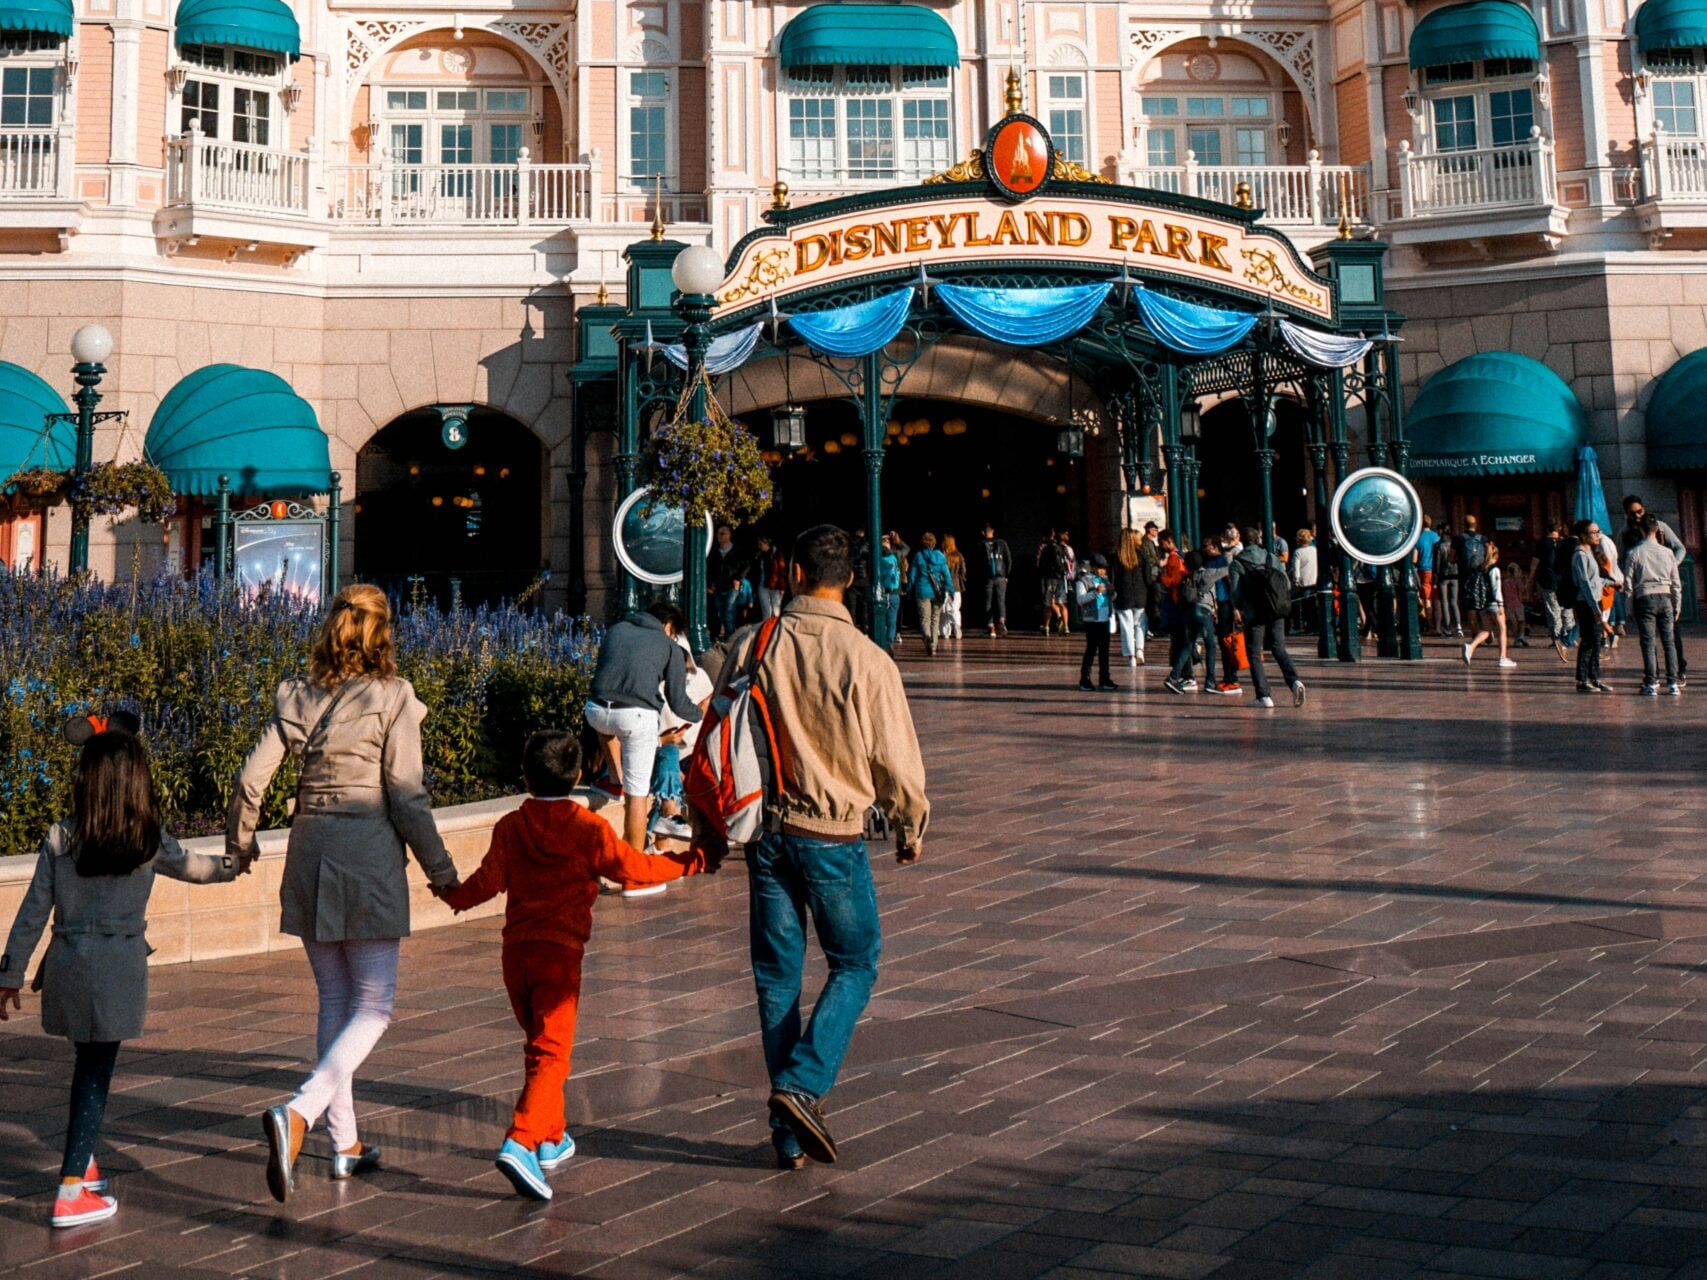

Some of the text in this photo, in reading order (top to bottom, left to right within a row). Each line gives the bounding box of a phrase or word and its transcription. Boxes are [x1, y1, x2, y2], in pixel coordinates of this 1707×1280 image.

[794, 210, 1233, 276] DISNEYLAND PARK
[448, 426, 461, 442] 8
[1471, 457, 1478, 466] A
[1480, 454, 1536, 465] ECHANGER
